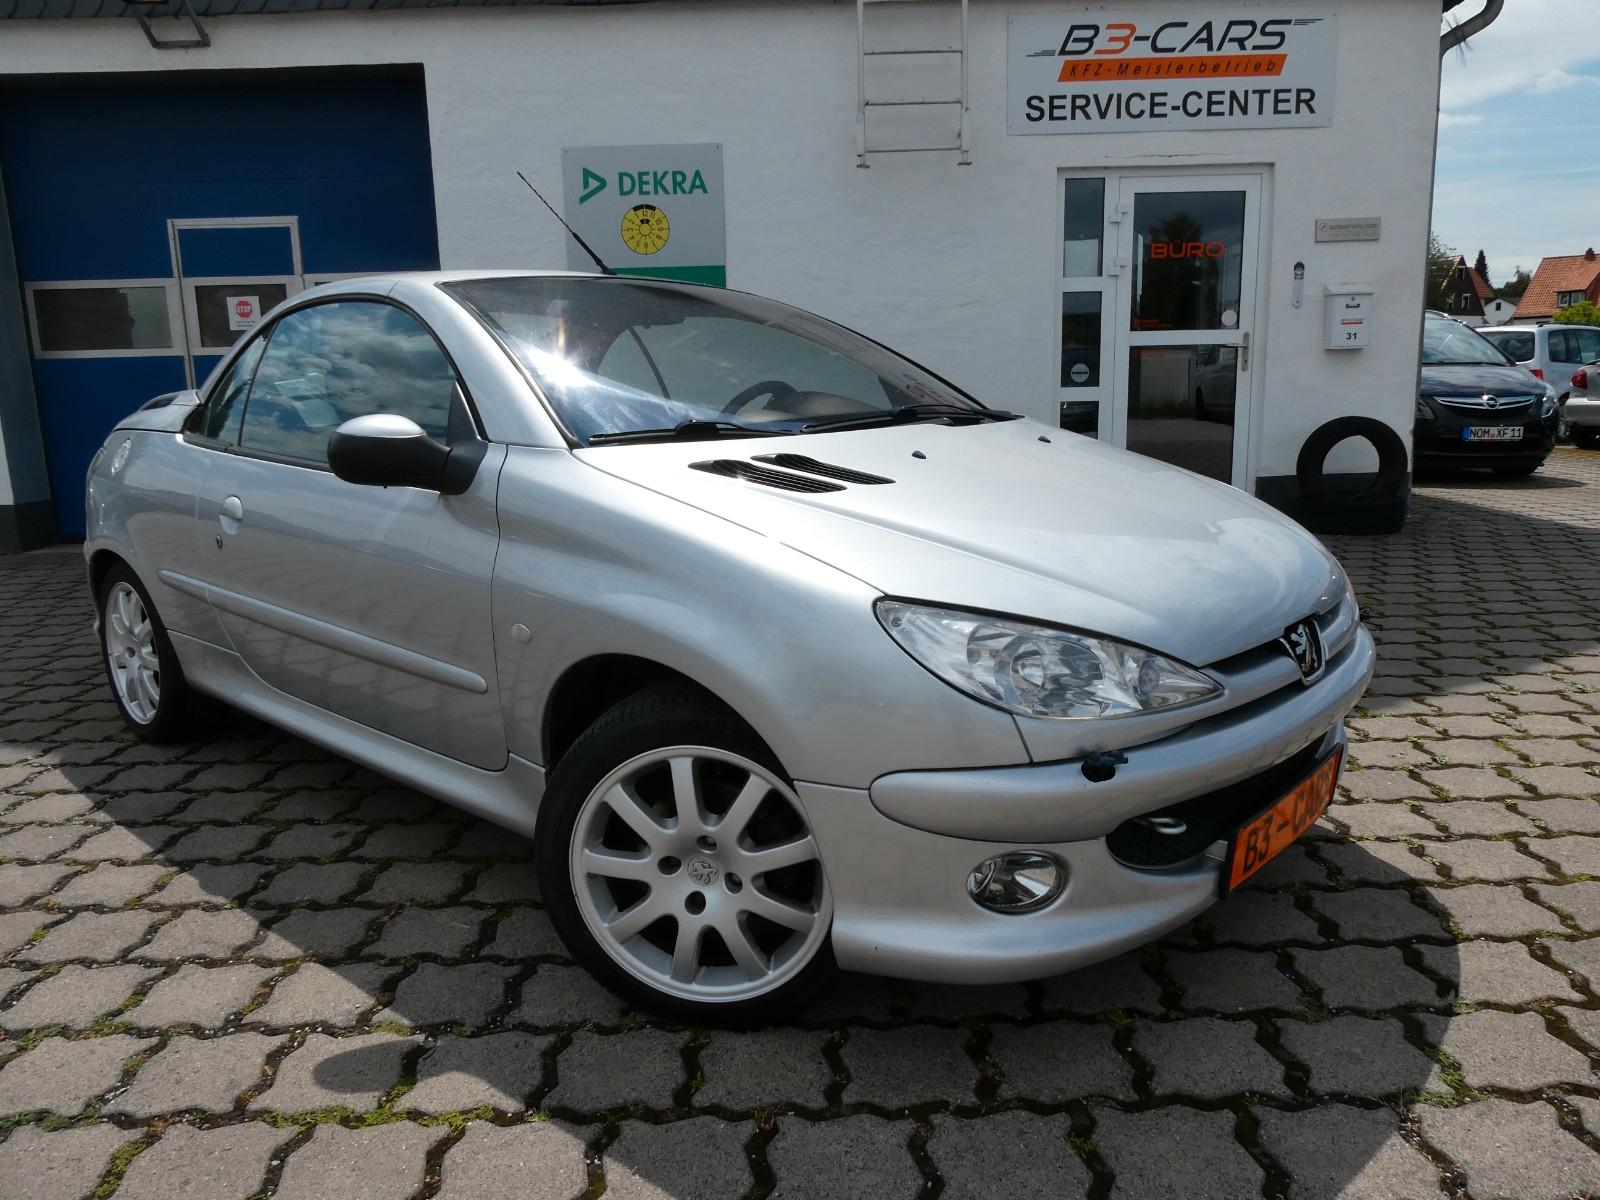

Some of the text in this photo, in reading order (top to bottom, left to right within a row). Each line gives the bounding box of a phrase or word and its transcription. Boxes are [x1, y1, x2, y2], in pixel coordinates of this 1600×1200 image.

[1058, 19, 1292, 56] B3-CARS
[1070, 60, 1275, 77] KFZ-Meisterbetrieb
[1025, 88, 1316, 122] SERVICE-CENTER
[618, 169, 709, 196] DEKRA
[236, 305, 252, 313] STOP
[1345, 332, 1357, 340] 31
[1469, 428, 1521, 438] NOM XF 11
